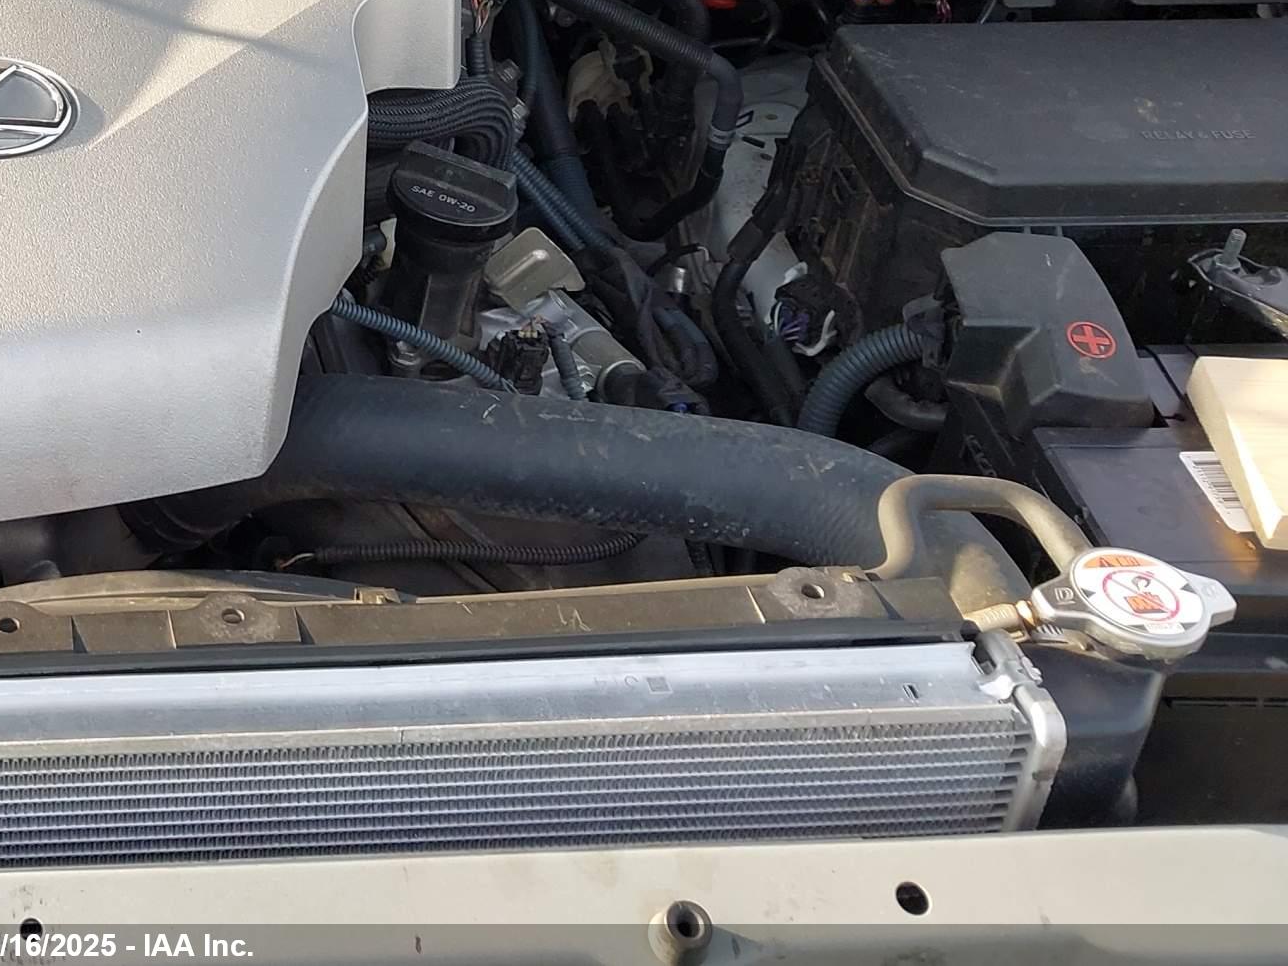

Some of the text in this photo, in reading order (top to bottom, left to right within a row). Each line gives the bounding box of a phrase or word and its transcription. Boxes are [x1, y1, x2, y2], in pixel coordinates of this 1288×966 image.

[1141, 129, 1194, 139] RELAY
[1211, 129, 1257, 139] FUSE
[410, 185, 476, 212] SAE 0W-20
